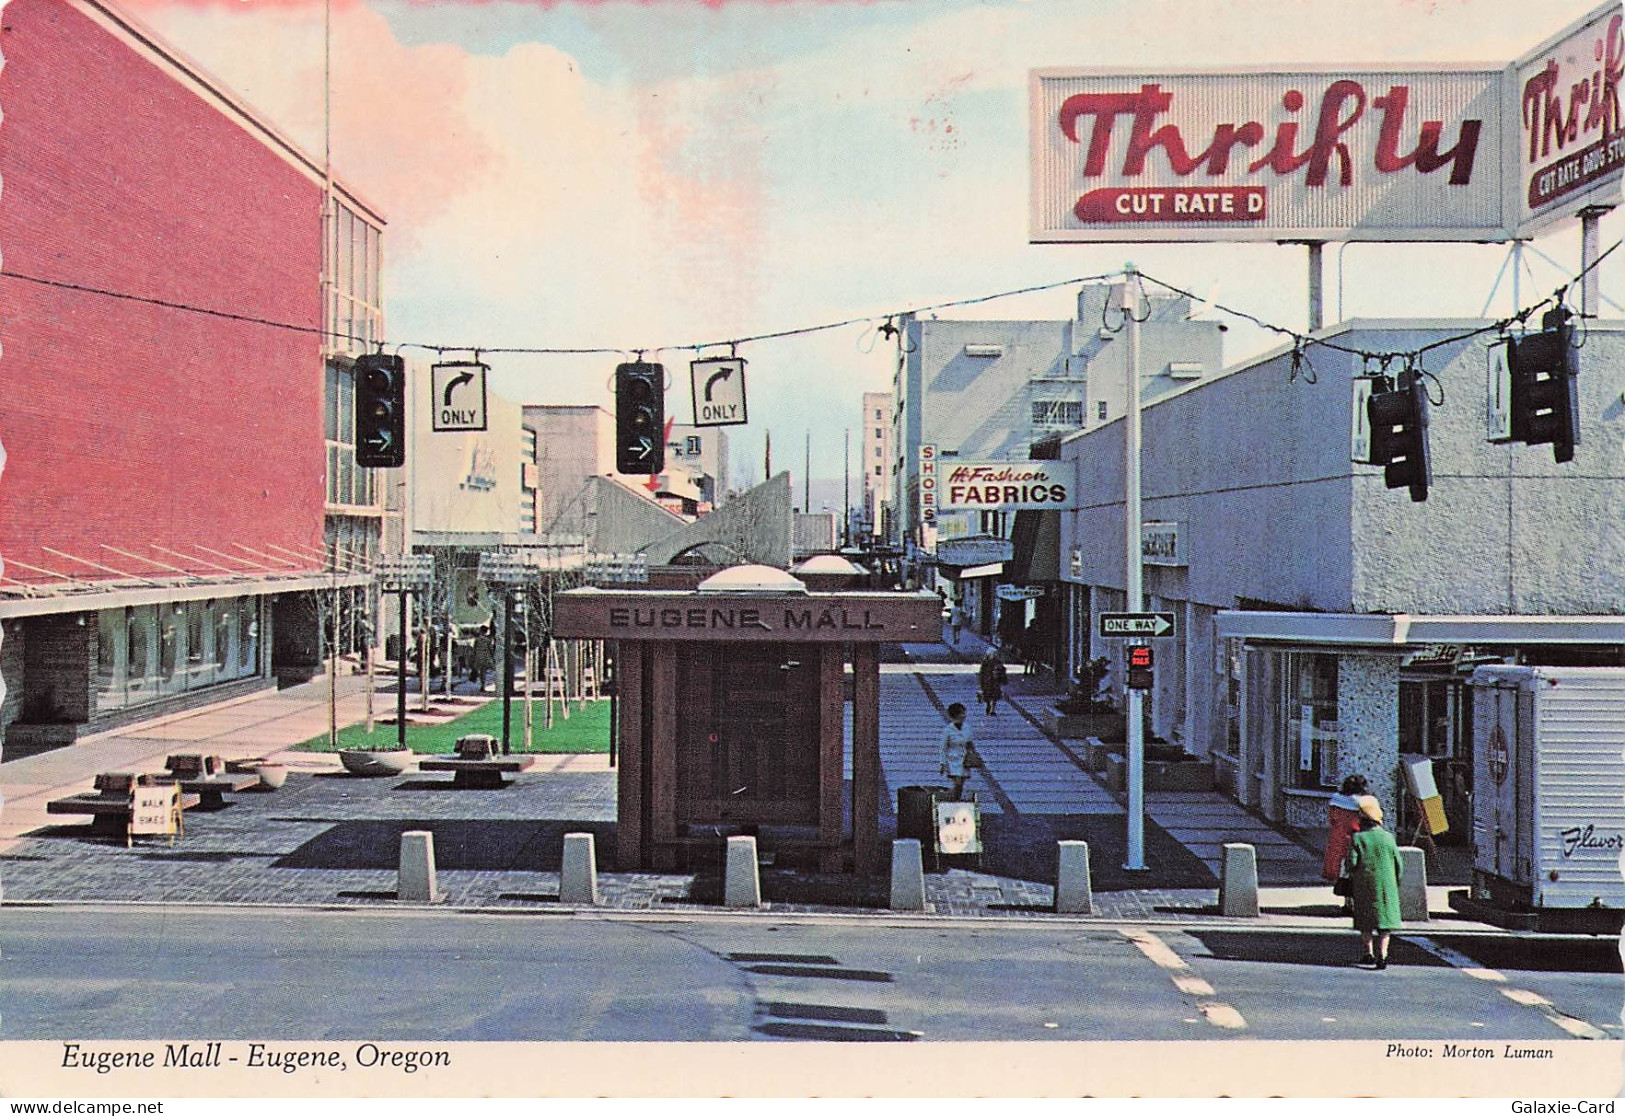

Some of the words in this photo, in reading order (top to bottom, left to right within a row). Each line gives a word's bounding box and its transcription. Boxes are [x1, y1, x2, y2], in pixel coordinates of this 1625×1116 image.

[1058, 80, 1483, 187] Thrifty
[1540, 171, 1557, 196] CUT
[1558, 160, 1580, 188] RATE
[1115, 192, 1162, 215] CUT
[1174, 192, 1235, 215] RATE
[1247, 192, 1265, 214] D
[441, 408, 478, 426] ONLY
[702, 403, 739, 421] ONLY
[922, 445, 935, 521] SHOES
[950, 485, 1067, 505] FABRICS
[609, 608, 759, 628] EUGENE
[783, 609, 885, 631] MALL
[1106, 620, 1130, 631] ONE
[1135, 620, 1157, 631] WAY
[1561, 826, 1623, 857] Flavor
